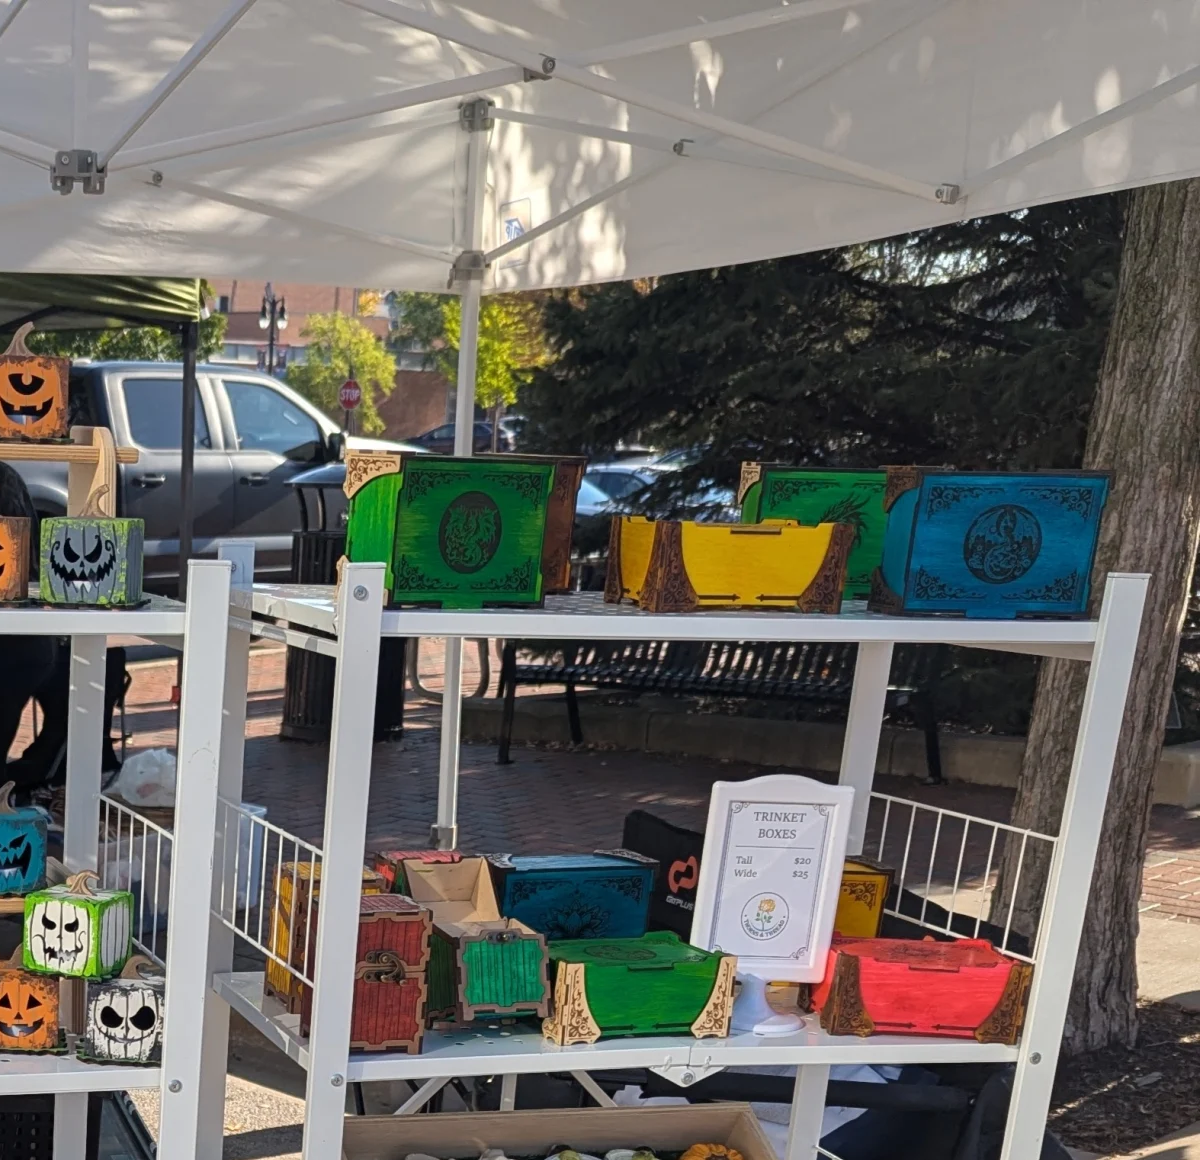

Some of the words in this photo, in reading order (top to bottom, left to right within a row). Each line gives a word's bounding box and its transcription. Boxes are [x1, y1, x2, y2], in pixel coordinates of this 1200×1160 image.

[340, 389, 360, 401] STOP
[754, 812, 807, 823] TRINKET
[758, 828, 797, 840] BOXES
[736, 856, 753, 865] Tall
[794, 857, 811, 866] $20
[734, 869, 758, 878] Wide
[792, 870, 809, 879] $25
